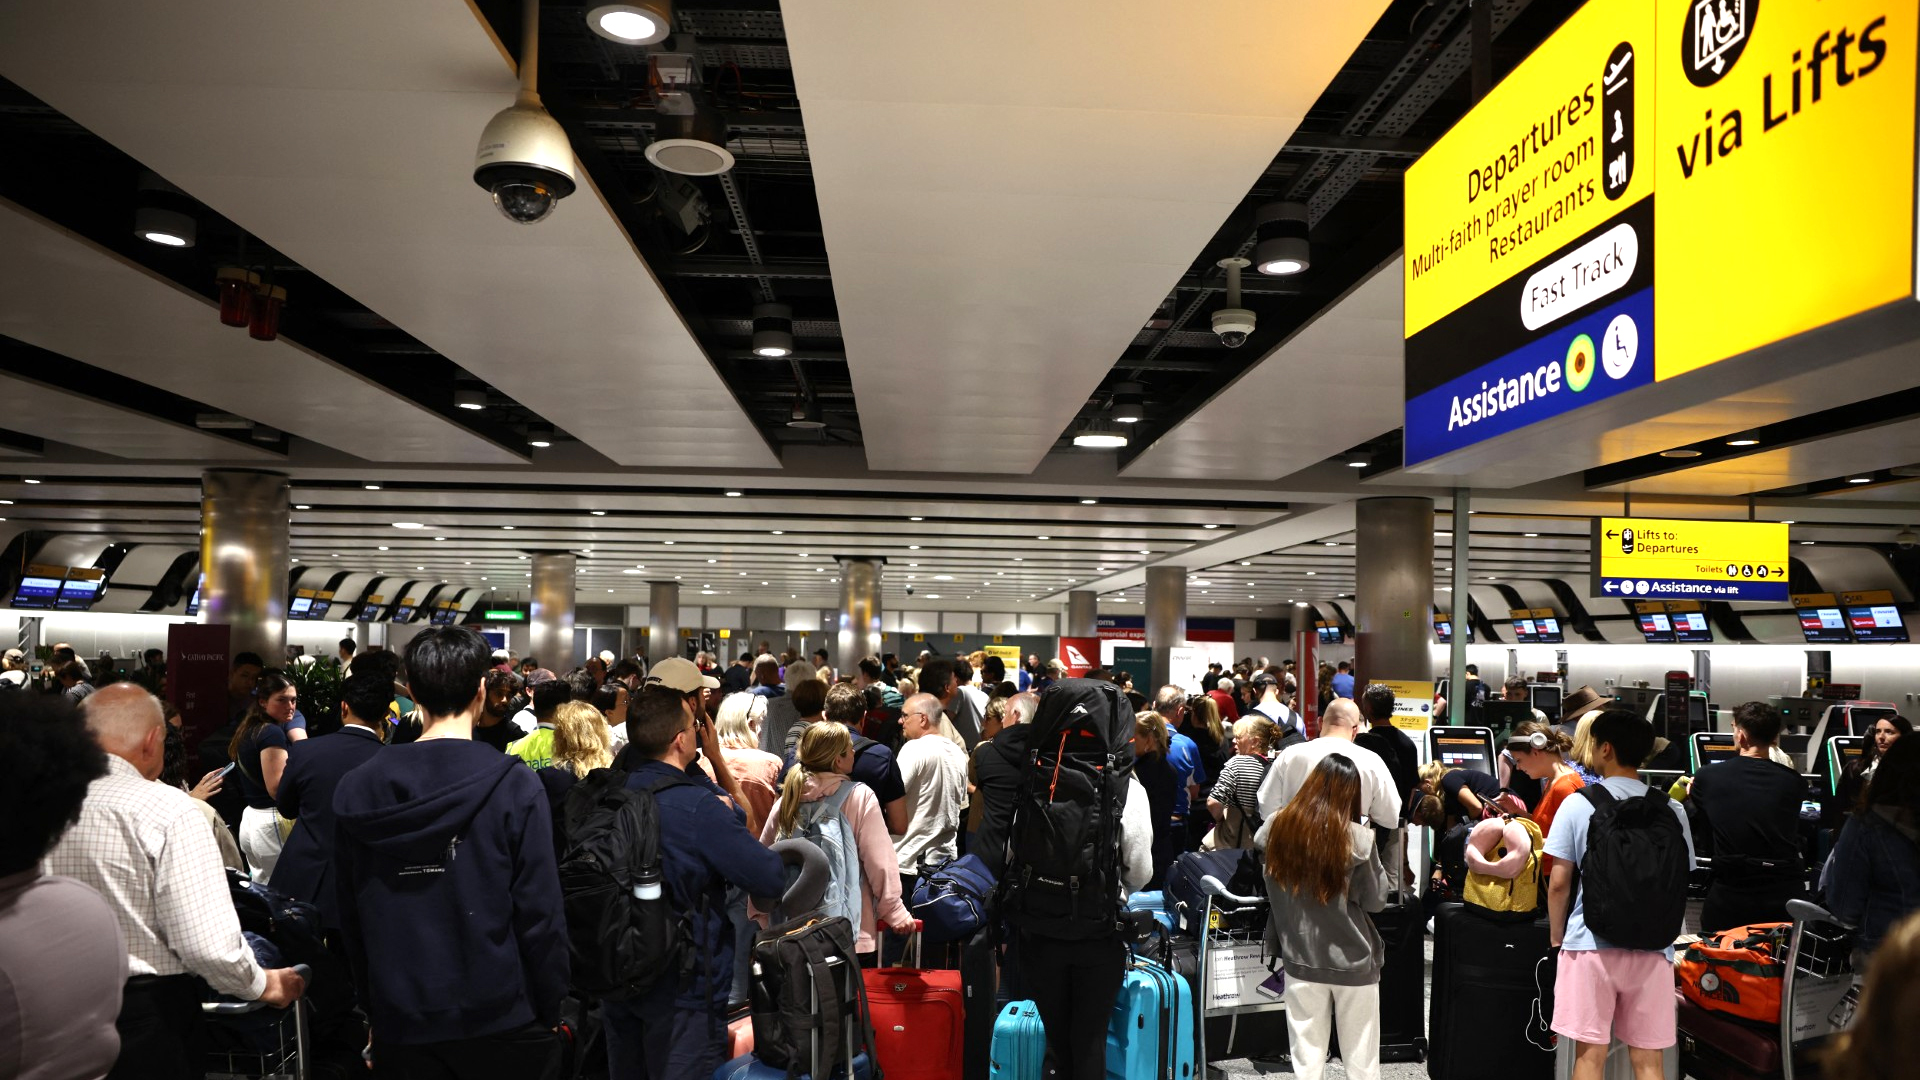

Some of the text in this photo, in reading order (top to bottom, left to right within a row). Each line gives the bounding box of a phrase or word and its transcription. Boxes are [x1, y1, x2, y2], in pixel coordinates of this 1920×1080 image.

[1676, 15, 1887, 180] via Lifts
[1467, 81, 1595, 203] Departures
[1412, 136, 1595, 281] Multi-faith prayer room
[1489, 176, 1595, 263] Restaurants
[1530, 241, 1625, 313] Fast Track
[1448, 359, 1561, 432] Assistance
[1637, 530, 1678, 540] Lifts to:
[1637, 543, 1699, 555] Departures
[1696, 565, 1723, 573] Toilets
[1651, 582, 1713, 594] Assistance
[1727, 586, 1739, 595] lift
